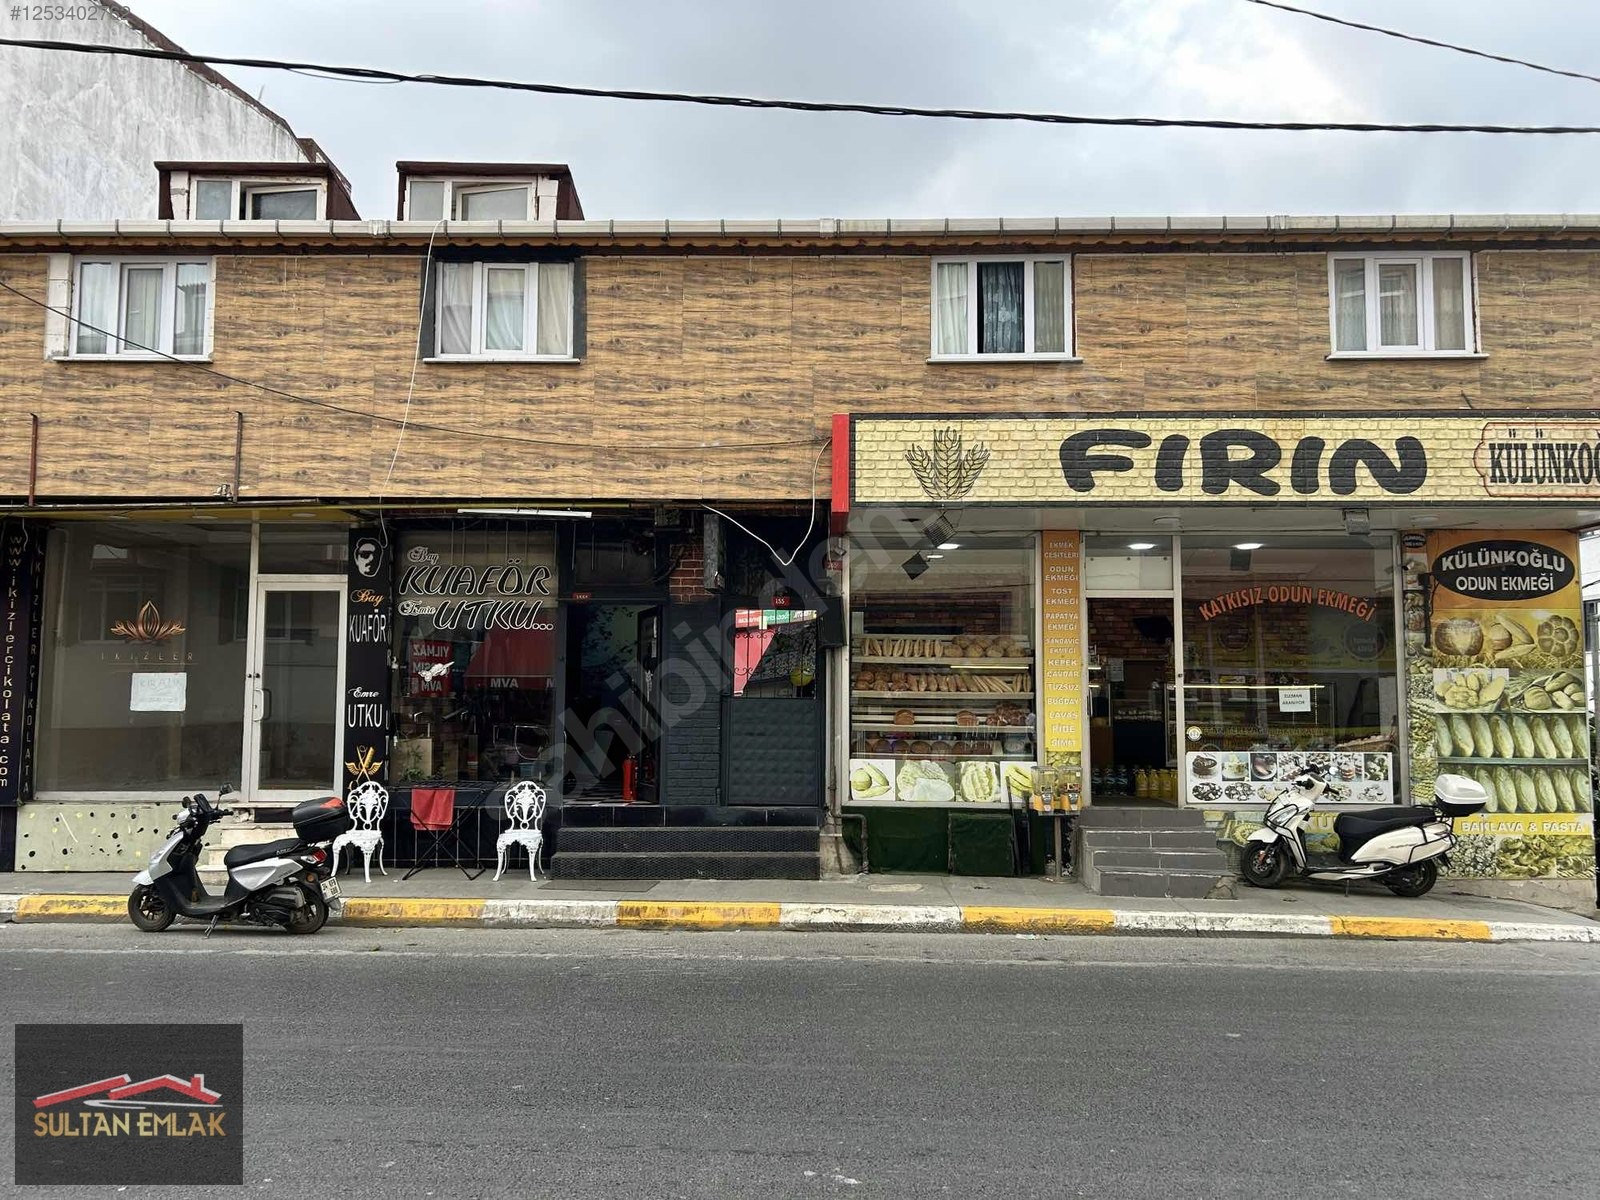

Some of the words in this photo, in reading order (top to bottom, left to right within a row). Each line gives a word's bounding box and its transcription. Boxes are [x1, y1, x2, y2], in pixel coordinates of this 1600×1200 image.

[1059, 428, 1428, 496] FIRIN
[407, 546, 440, 565] Bay
[1442, 548, 1566, 572] KÜLÜNKOĞLU
[399, 558, 552, 595] KUAFÖR
[1456, 576, 1497, 591] ODUN
[1501, 573, 1554, 591] EKMEĞİ
[350, 588, 385, 607] Bay
[1199, 587, 1264, 621] KATKISIZ
[1268, 586, 1312, 604] ODUN
[1317, 588, 1377, 622] EKMEĞİ
[349, 608, 387, 642] KUAFÖR
[1045, 612, 1079, 620] PAPATYA
[348, 687, 380, 698] Emre
[348, 704, 383, 727] UTKU
[1462, 822, 1524, 832] BAKLAVA
[1529, 822, 1538, 832] &
[1543, 822, 1584, 832] PASTA
